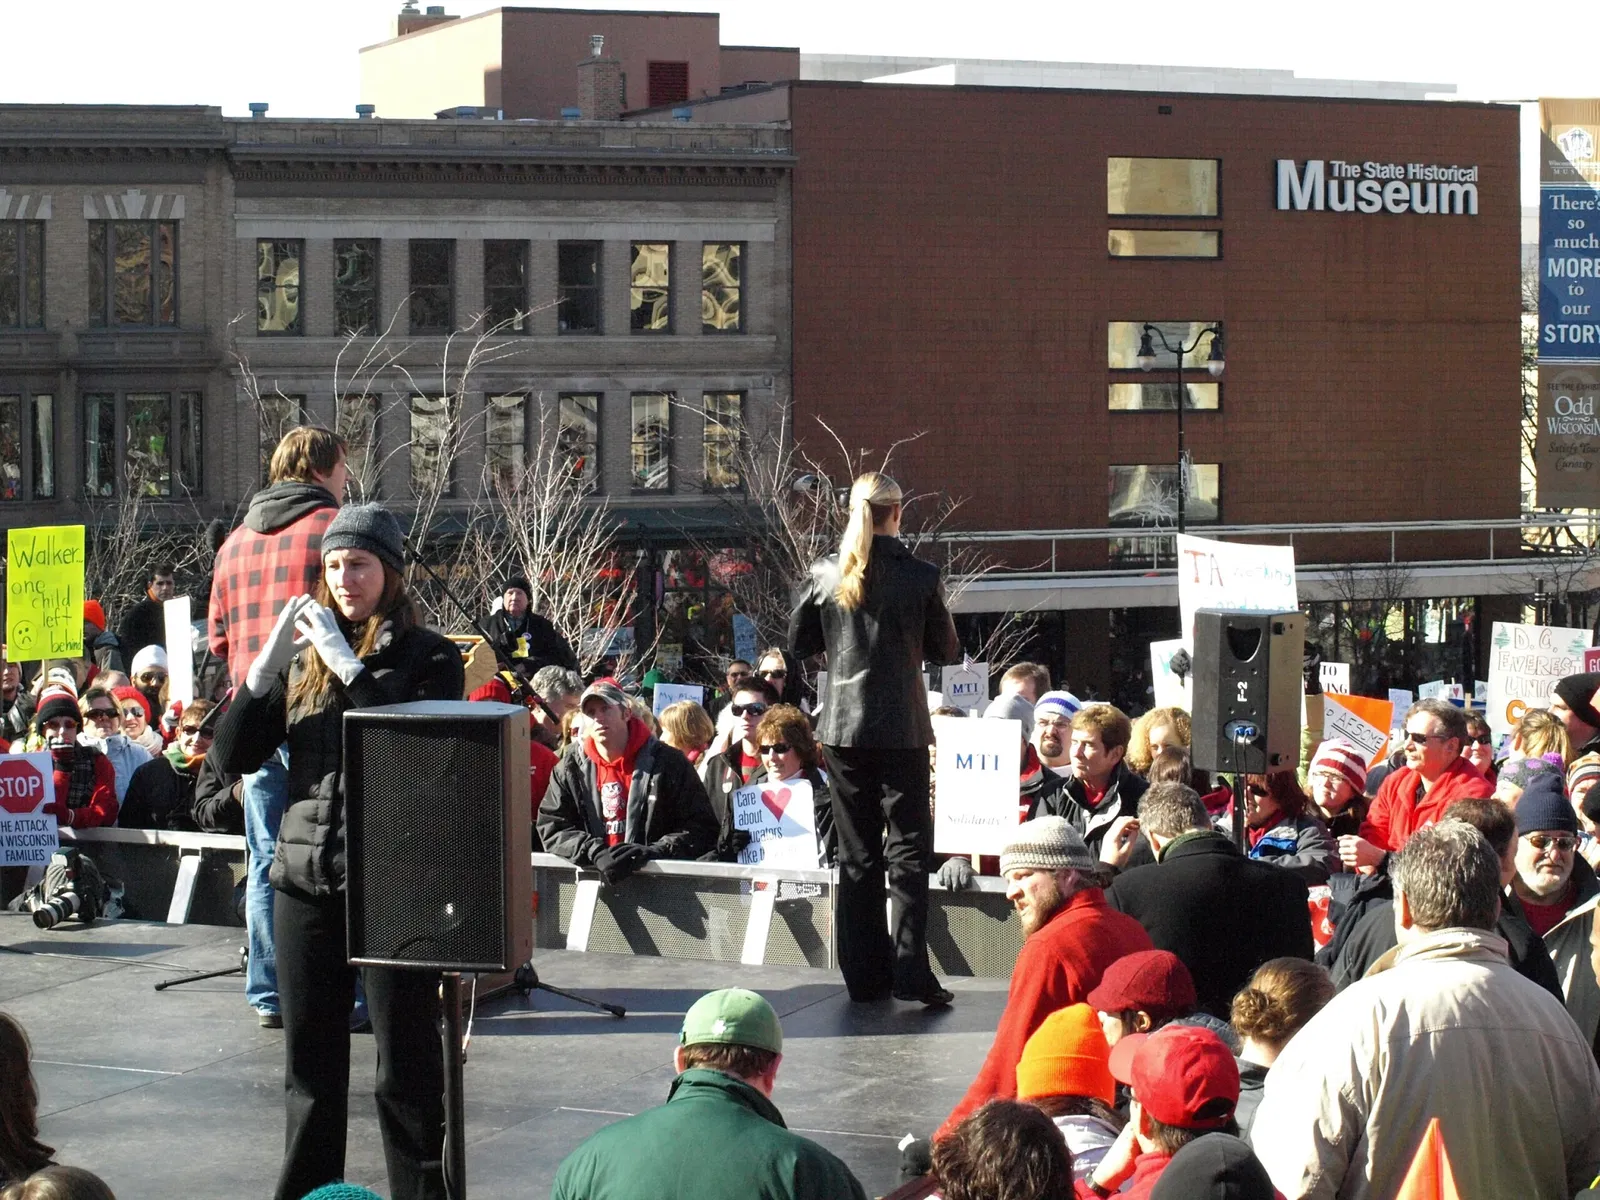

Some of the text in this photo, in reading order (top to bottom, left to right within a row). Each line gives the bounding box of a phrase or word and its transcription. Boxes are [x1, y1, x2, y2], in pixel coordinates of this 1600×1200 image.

[1329, 160, 1478, 183] The State Historical
[1277, 159, 1478, 215] Museum
[1567, 219, 1585, 229] so
[1554, 233, 1600, 249] much
[1547, 258, 1600, 278] MORE
[1568, 284, 1584, 296] to
[1561, 305, 1591, 315] our
[1554, 395, 1594, 416] Odd
[1184, 549, 1224, 587] TA
[11, 579, 46, 596] one
[32, 584, 71, 609] child
[43, 606, 72, 628] left
[50, 628, 83, 654] behind
[1498, 650, 1585, 677] EVEREST
[952, 682, 978, 694] MTI
[1237, 681, 1248, 702] F-2
[1334, 712, 1384, 750] AFSCME
[956, 753, 998, 770] MTI
[736, 791, 756, 808] Care
[14, 819, 49, 833] ATTACK
[738, 809, 763, 826] about
[5, 834, 56, 847] WISCONSIN
[748, 826, 783, 844] ucators
[5, 849, 45, 862] FAMILIES
